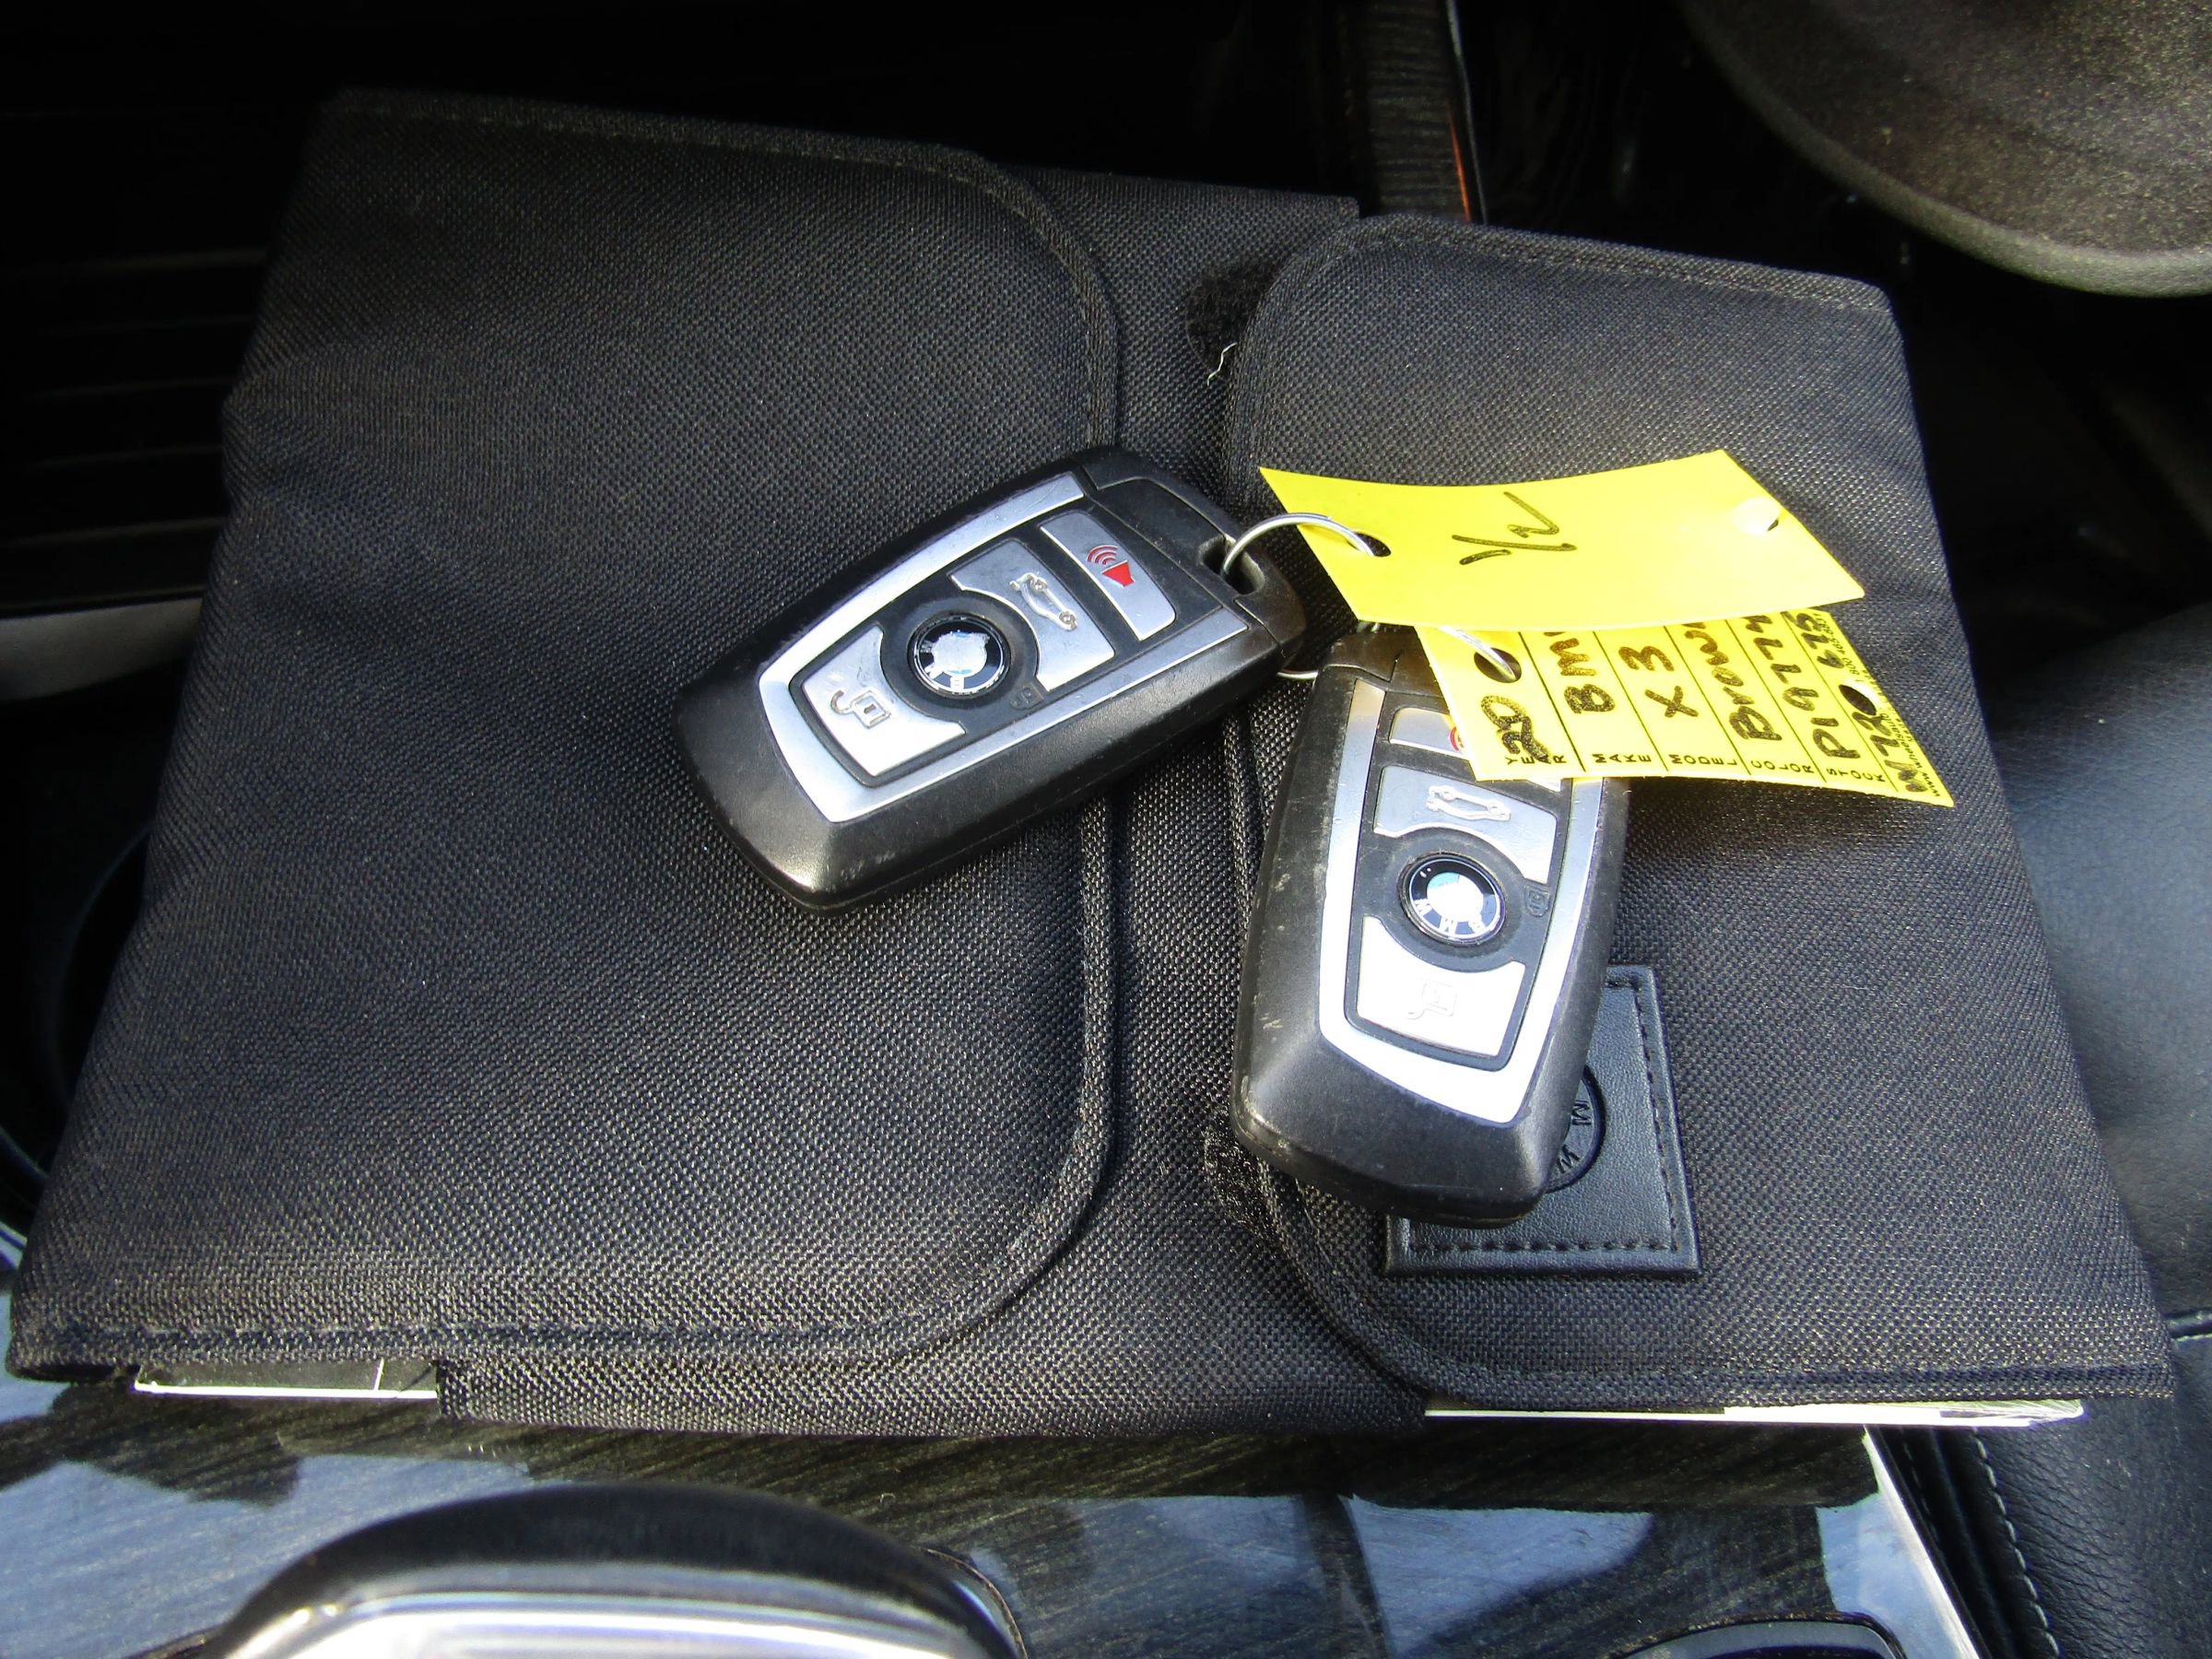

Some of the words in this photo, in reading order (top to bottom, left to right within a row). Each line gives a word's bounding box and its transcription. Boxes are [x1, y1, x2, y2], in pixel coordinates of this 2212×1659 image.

[1543, 631, 1616, 715] BM
[1504, 753, 1568, 766] YEAR
[1592, 753, 1653, 764] MAKE
[1667, 753, 1738, 767] MODEL
[1751, 759, 1815, 775] COLOR
[1827, 767, 1887, 783] STOCK
[1556, 1099, 1593, 1174] MW
